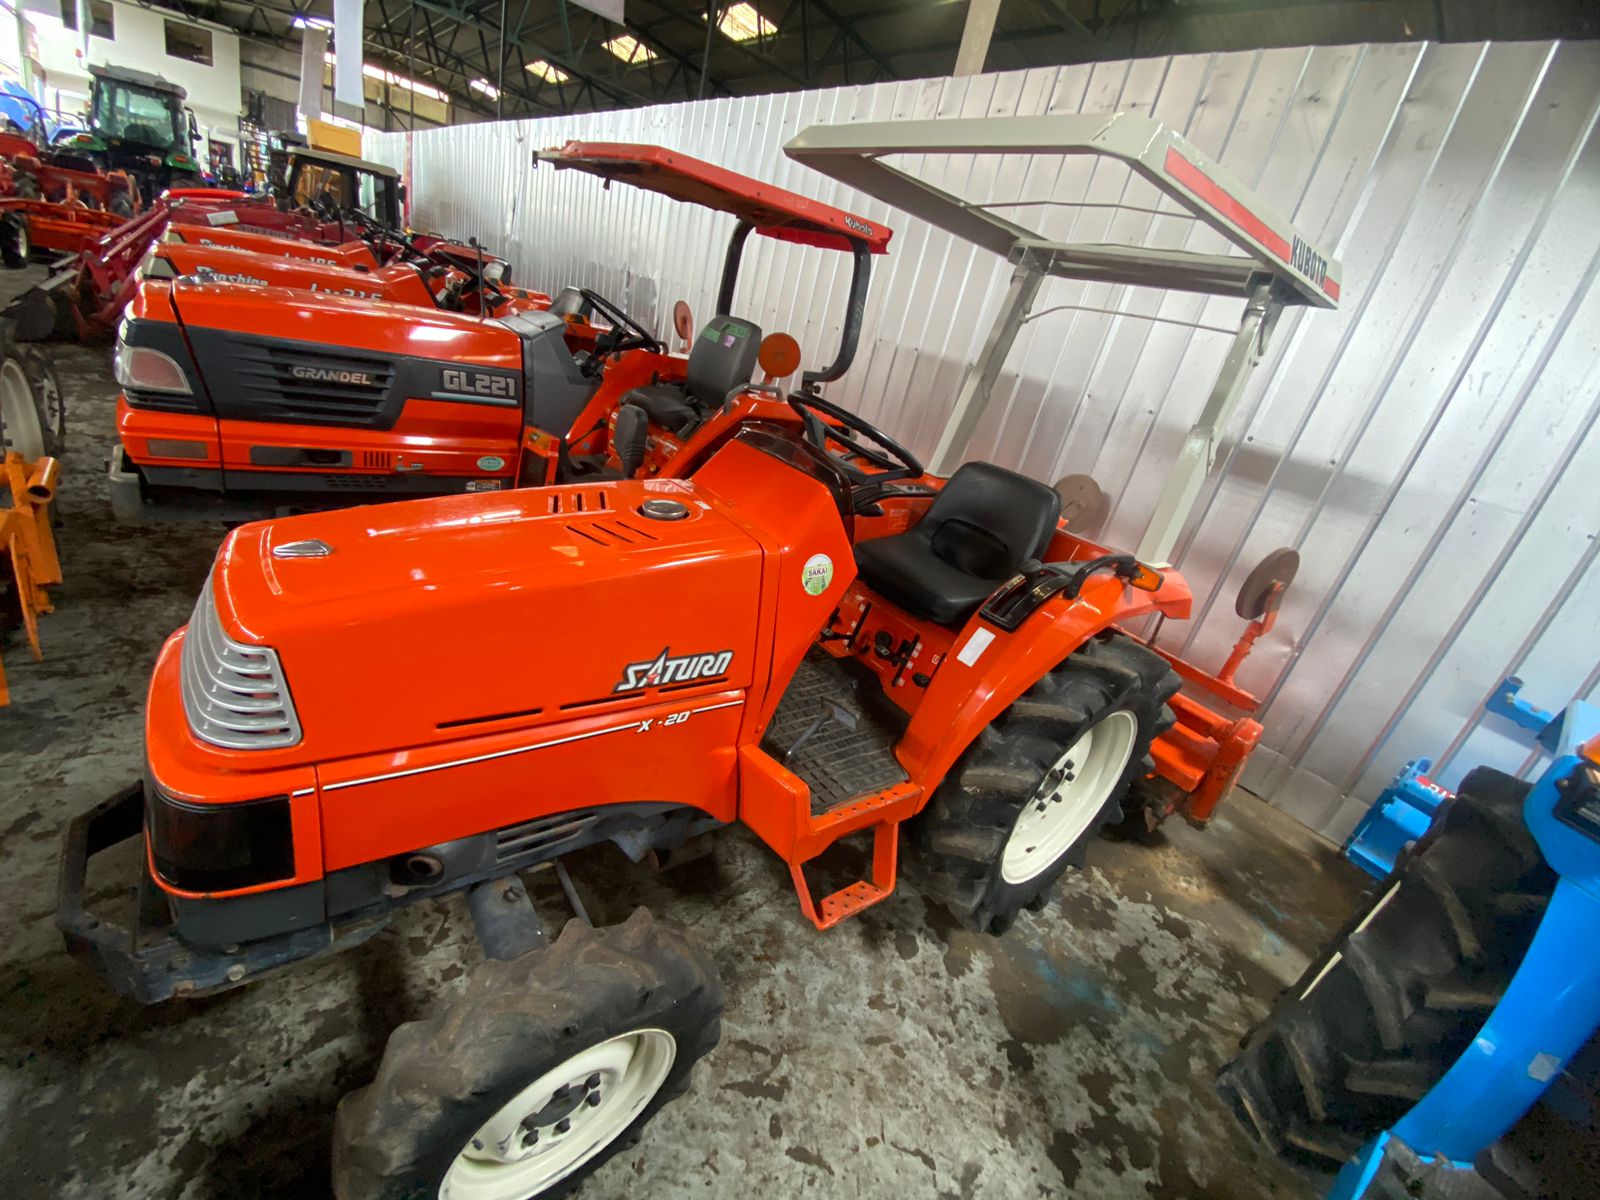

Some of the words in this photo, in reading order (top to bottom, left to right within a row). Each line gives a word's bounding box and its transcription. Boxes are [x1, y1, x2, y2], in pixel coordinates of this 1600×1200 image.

[845, 215, 873, 236] Kubota
[199, 238, 256, 256] Sunshi
[1290, 233, 1328, 290] KUBOTA
[292, 366, 372, 385] GRANDEL
[443, 369, 515, 397] GL221
[808, 567, 828, 577] SAKAI
[613, 646, 735, 694] SATURN
